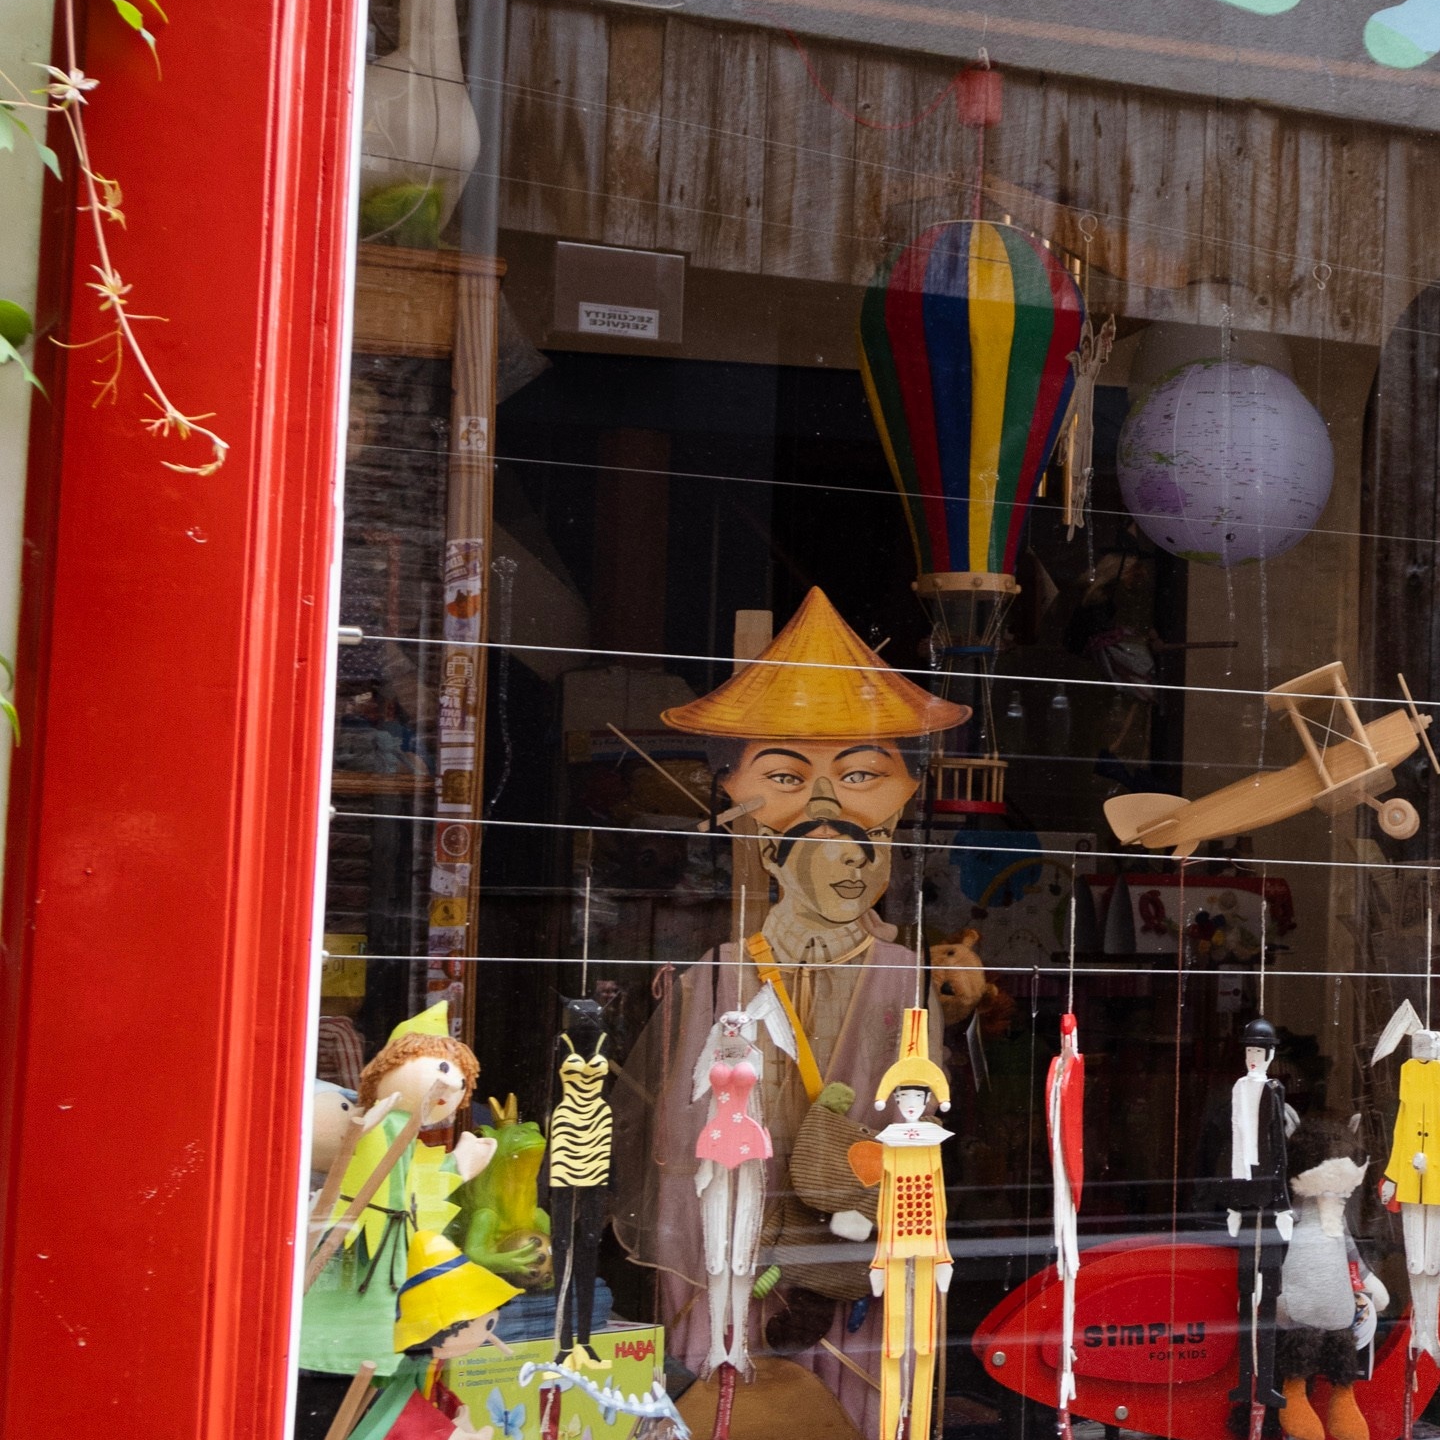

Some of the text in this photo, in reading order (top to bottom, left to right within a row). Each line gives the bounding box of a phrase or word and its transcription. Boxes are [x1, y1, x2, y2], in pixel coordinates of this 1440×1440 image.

[901, 839, 948, 860] BBY
[614, 1340, 656, 1361] HABA
[1178, 1349, 1207, 1360] KIDS
